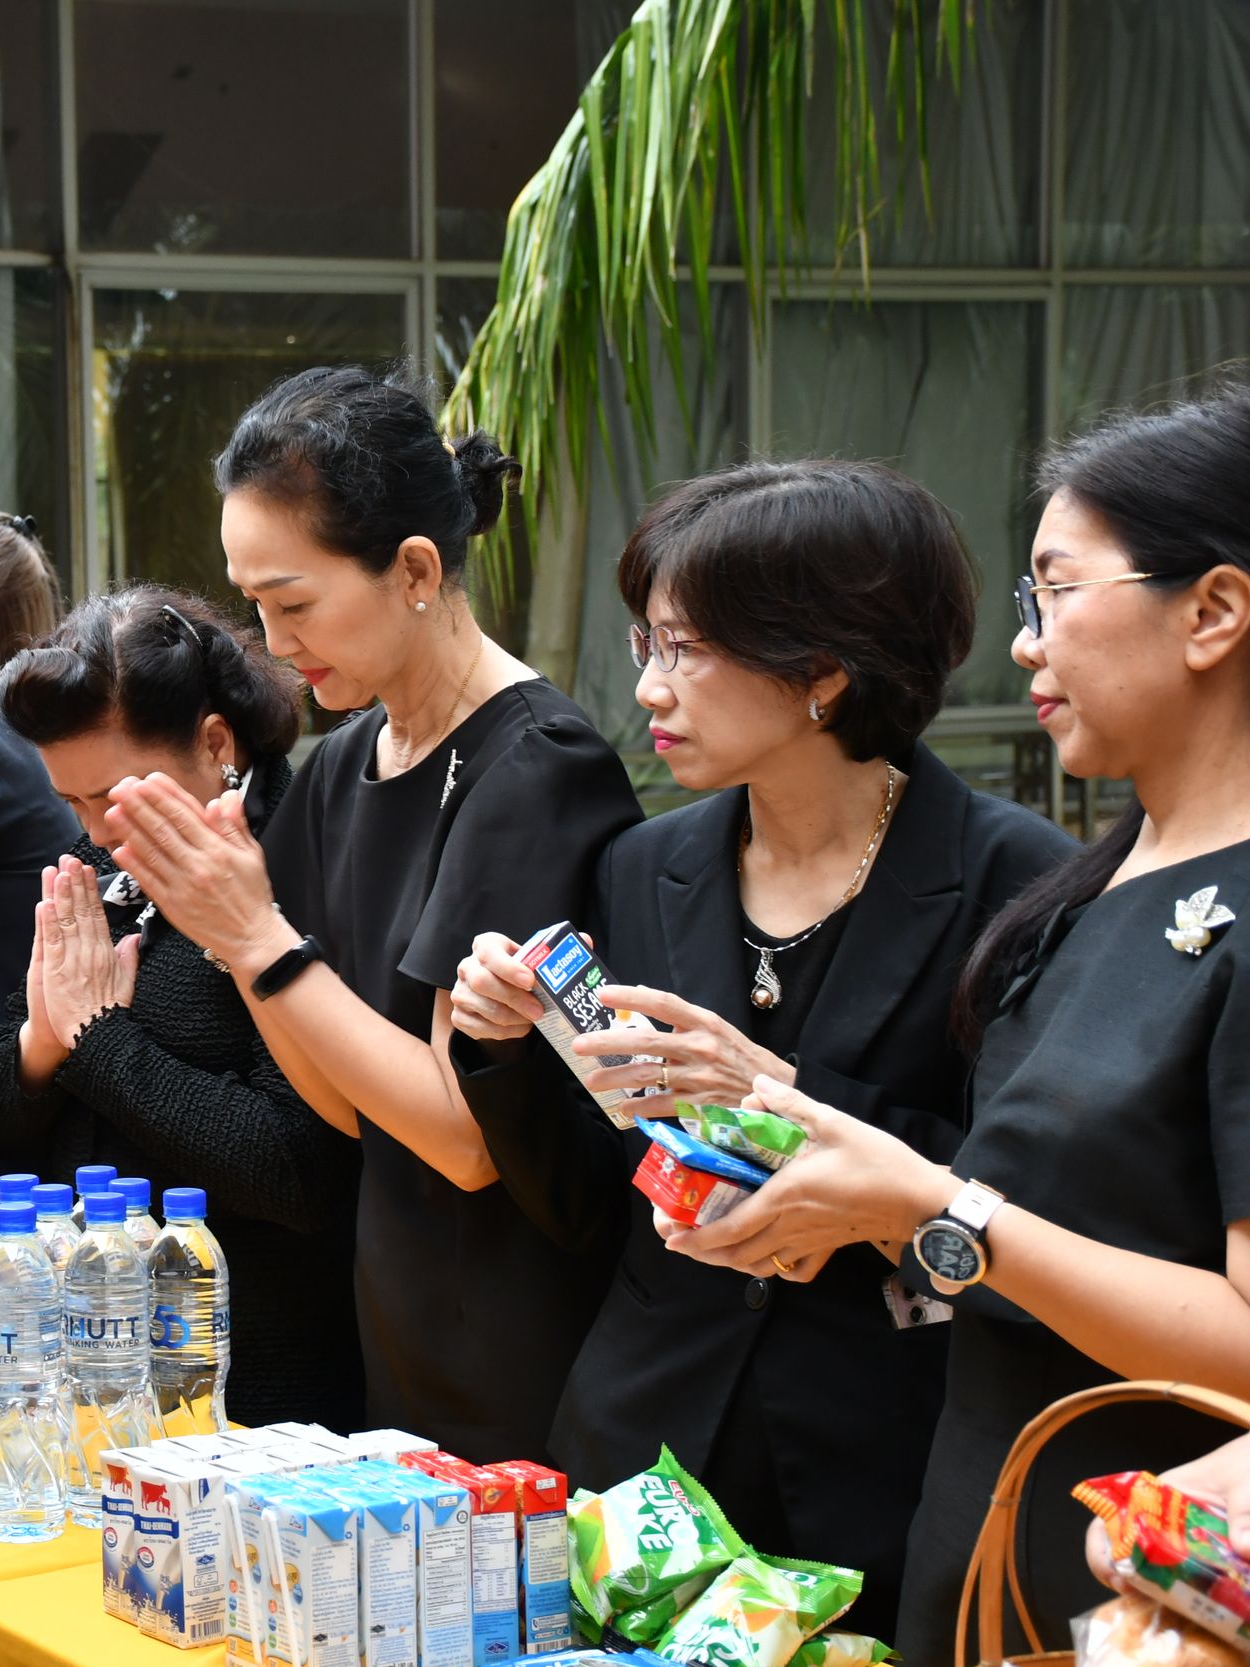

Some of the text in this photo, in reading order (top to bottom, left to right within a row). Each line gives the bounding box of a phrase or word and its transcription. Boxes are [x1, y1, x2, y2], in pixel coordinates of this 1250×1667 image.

[541, 944, 583, 988] Lactasoy
[562, 982, 589, 1010] BLACK
[572, 978, 607, 1028] SESA
[105, 1339, 140, 1349] WATER
